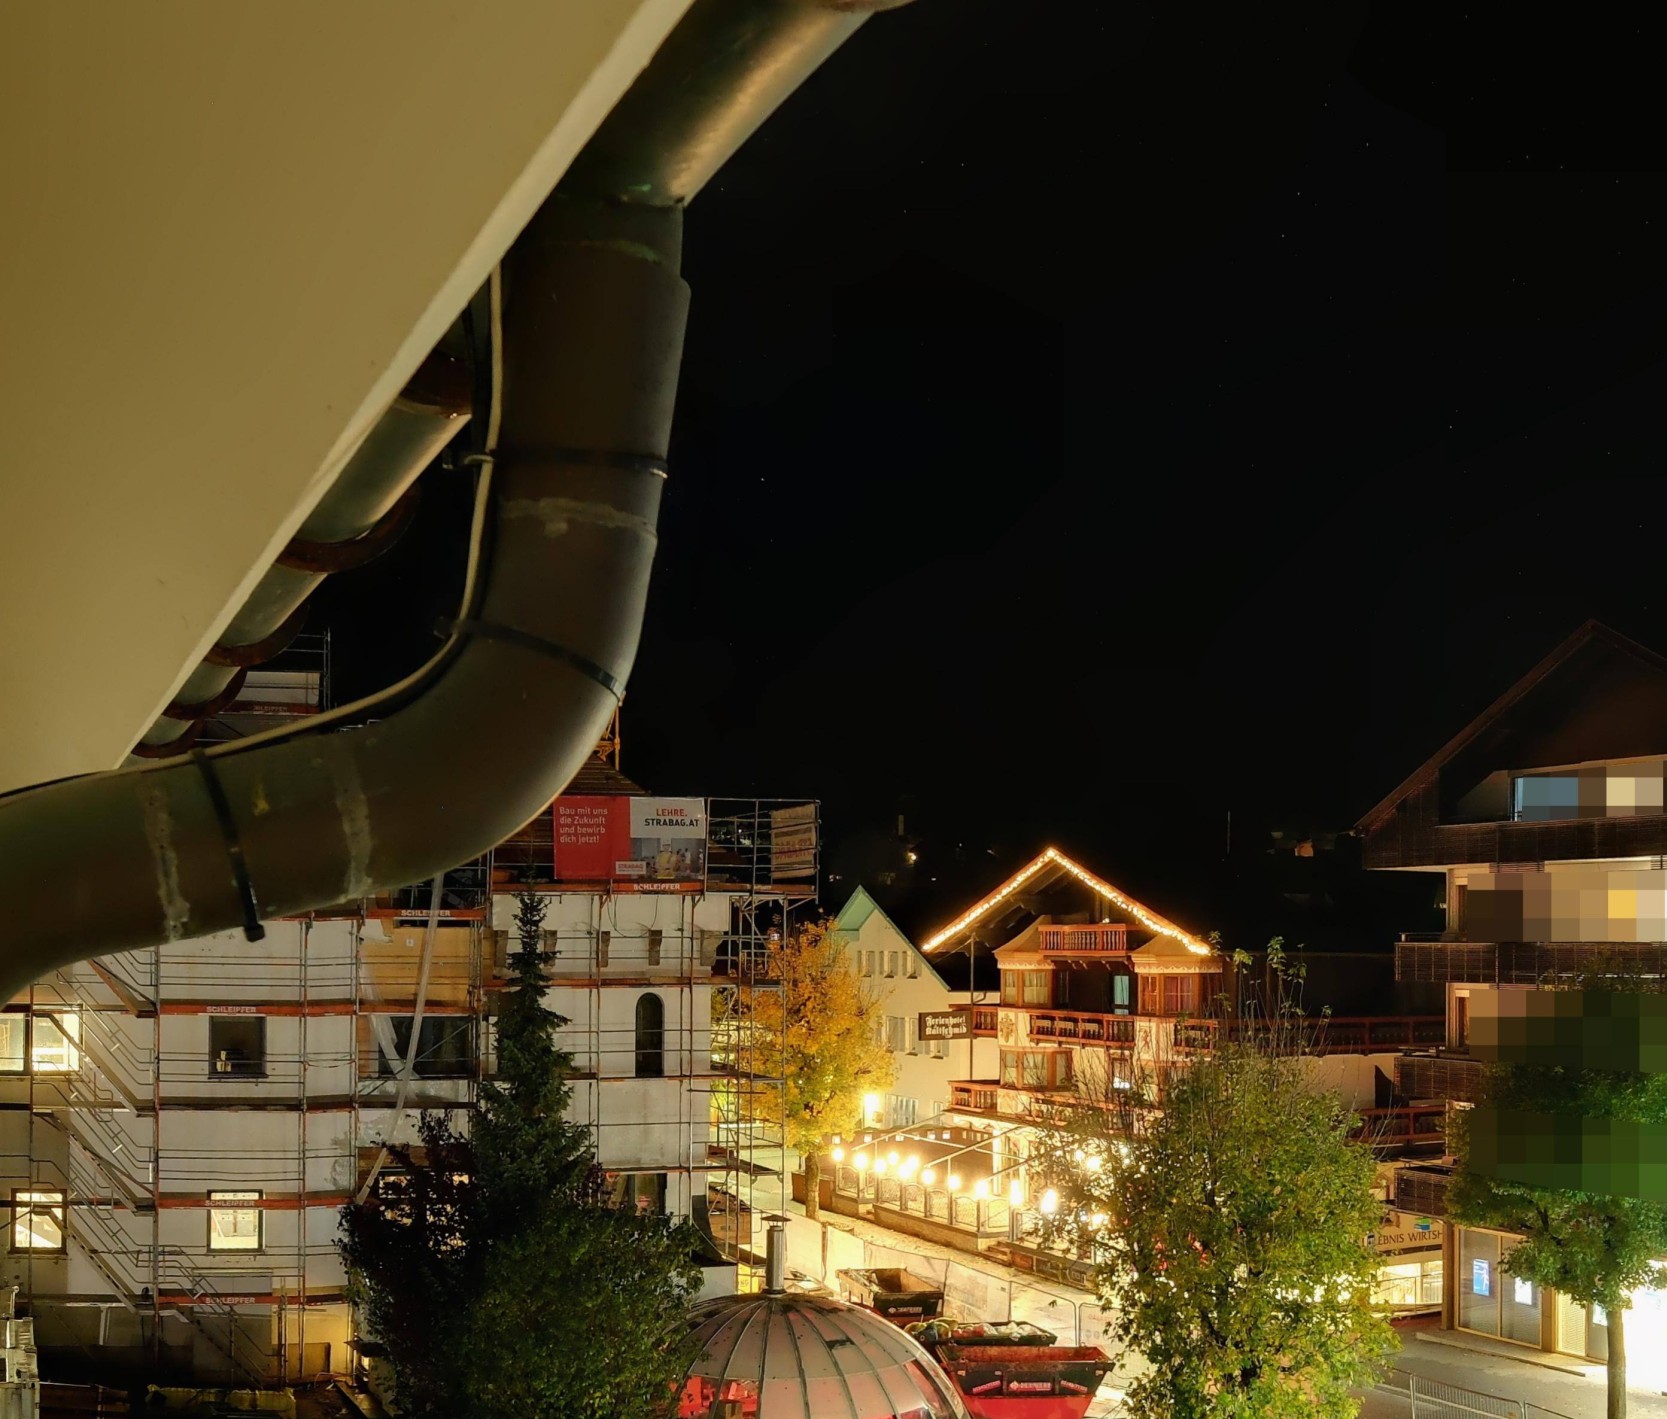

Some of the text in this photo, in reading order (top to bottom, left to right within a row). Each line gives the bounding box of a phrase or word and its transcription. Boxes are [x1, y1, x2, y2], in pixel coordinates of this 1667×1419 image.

[559, 807, 575, 815] Bau
[577, 807, 591, 815] mit
[656, 808, 688, 817] LEHRE.
[559, 815, 606, 825] die Zukunft
[644, 817, 700, 828] STRABAG.AT
[559, 825, 605, 834] und bewirb
[559, 834, 575, 843] dich
